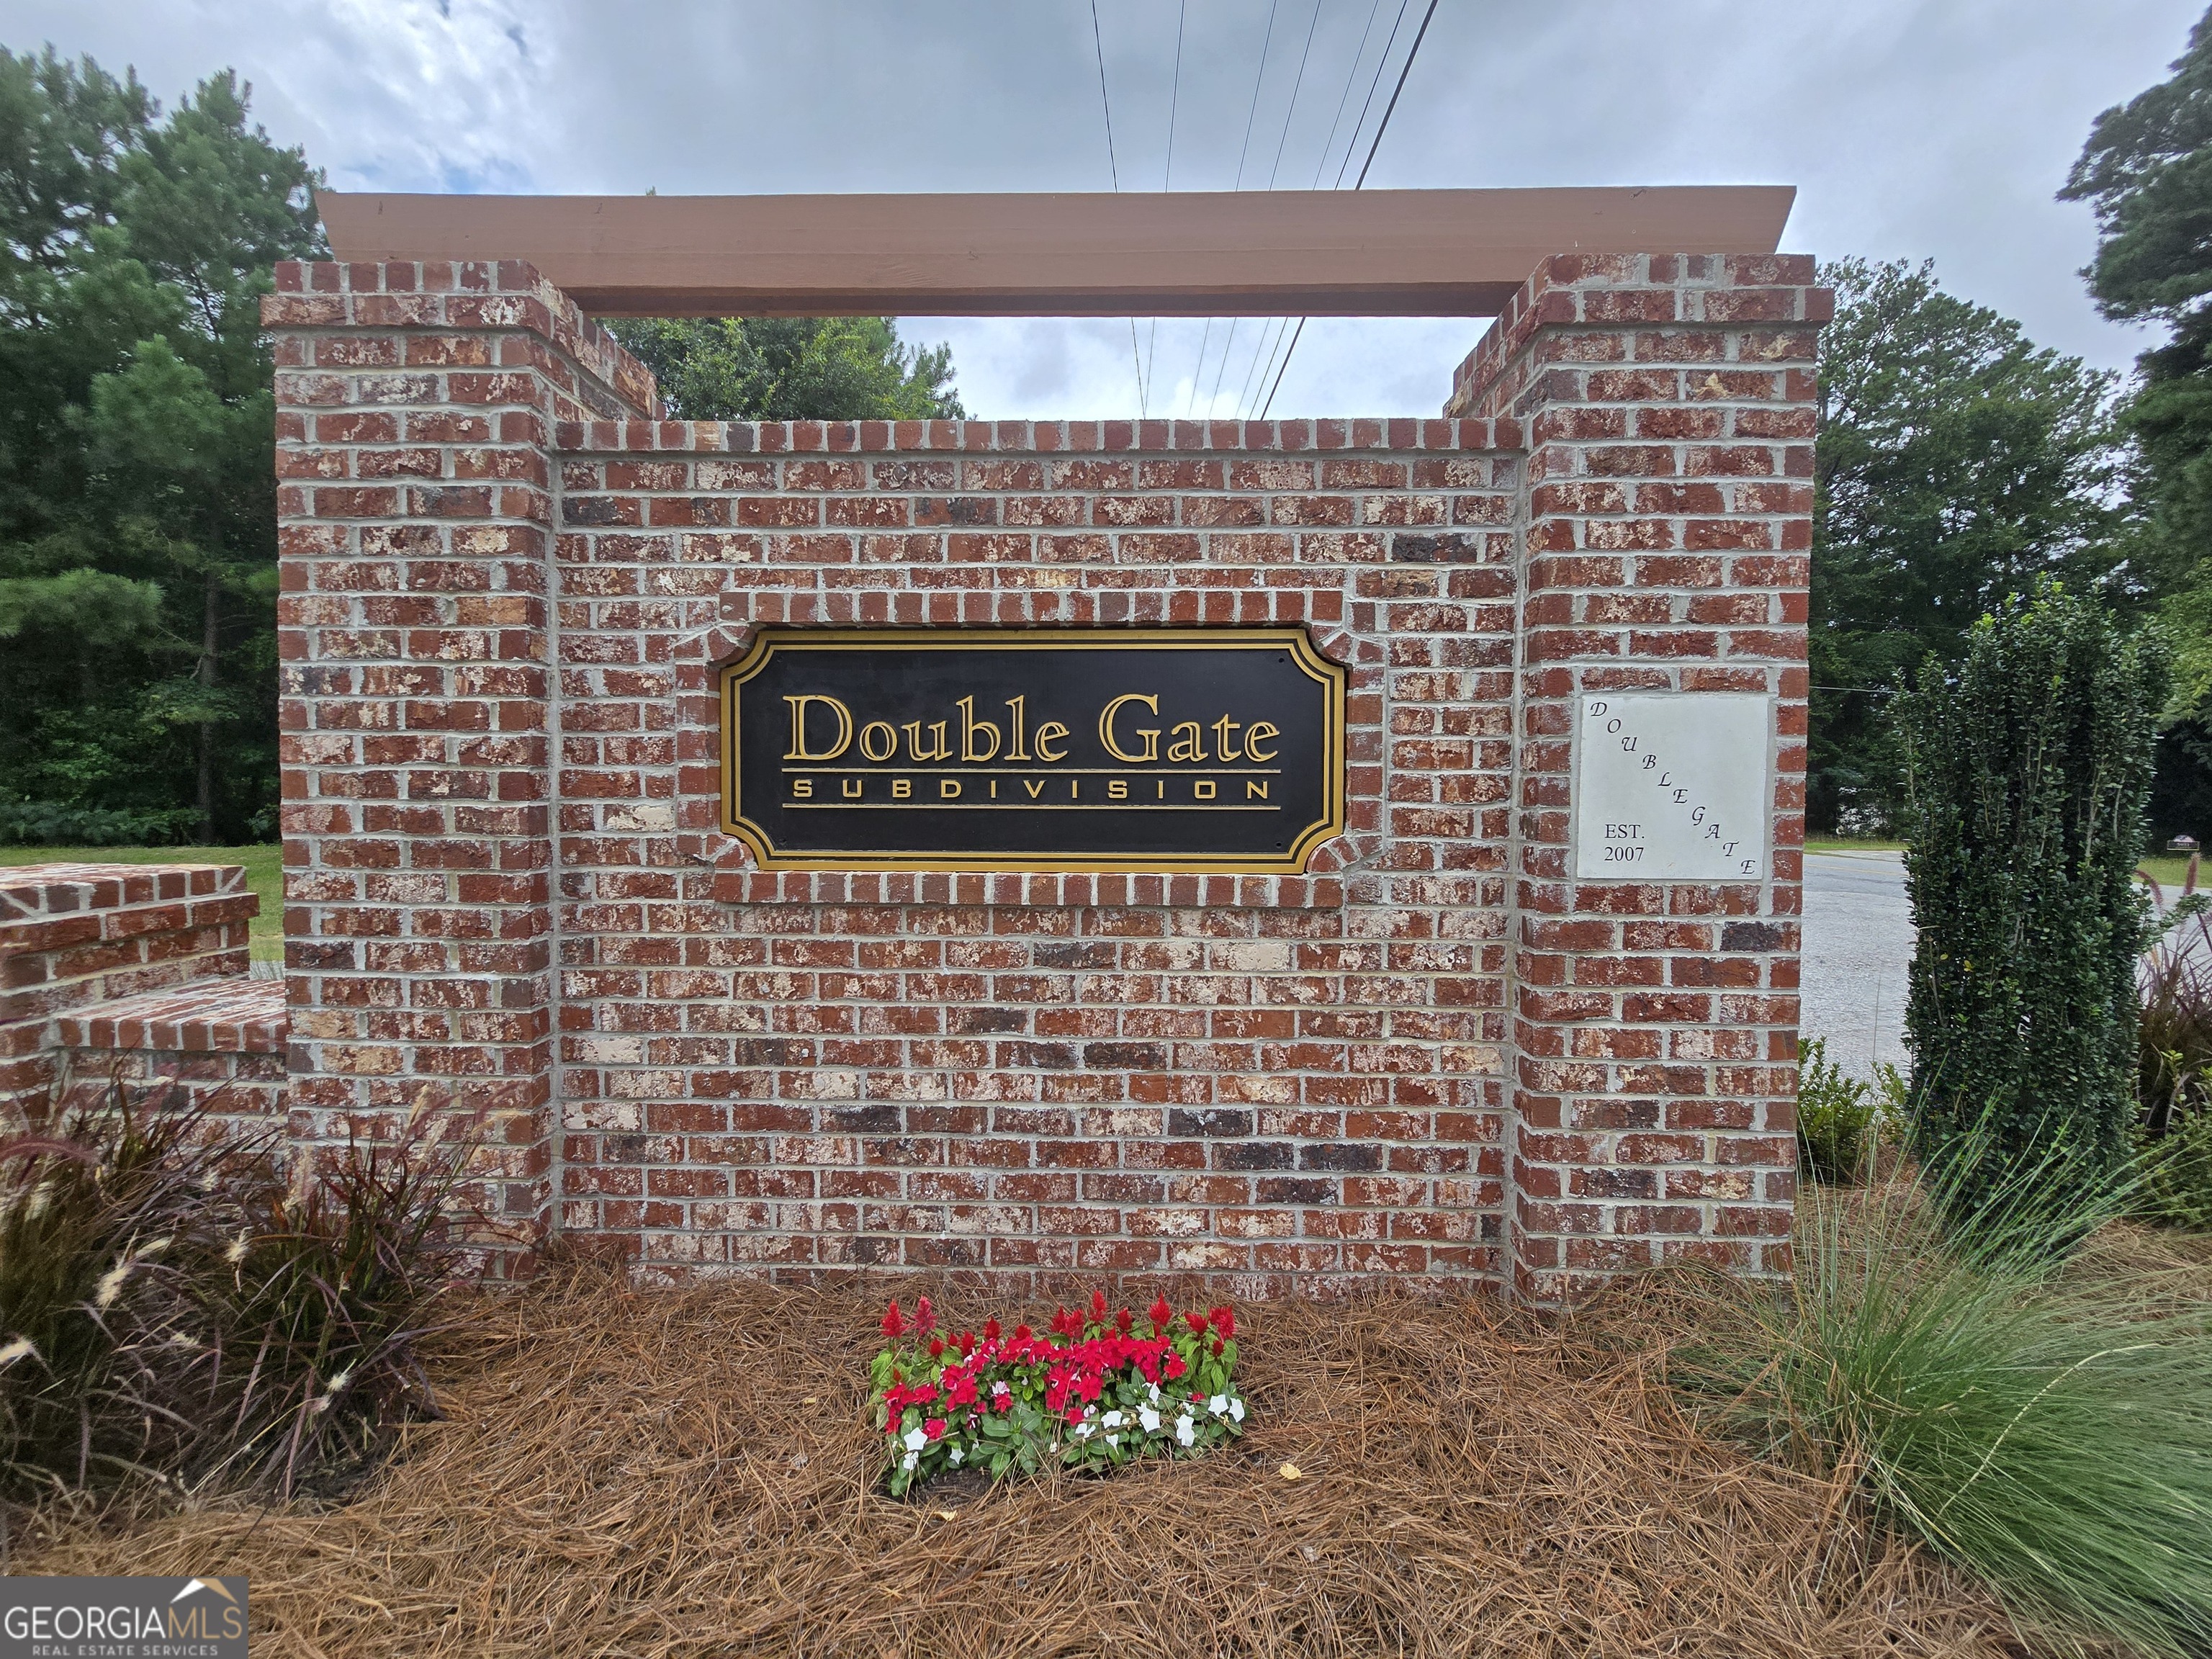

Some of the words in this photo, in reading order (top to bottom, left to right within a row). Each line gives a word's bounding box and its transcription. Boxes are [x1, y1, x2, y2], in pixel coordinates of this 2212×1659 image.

[782, 694, 1070, 762] Double
[1099, 693, 1280, 763] Gate
[793, 778, 1269, 800] SUBDIVISION
[1604, 824, 1645, 839] EST.
[1604, 846, 1645, 861] 2007
